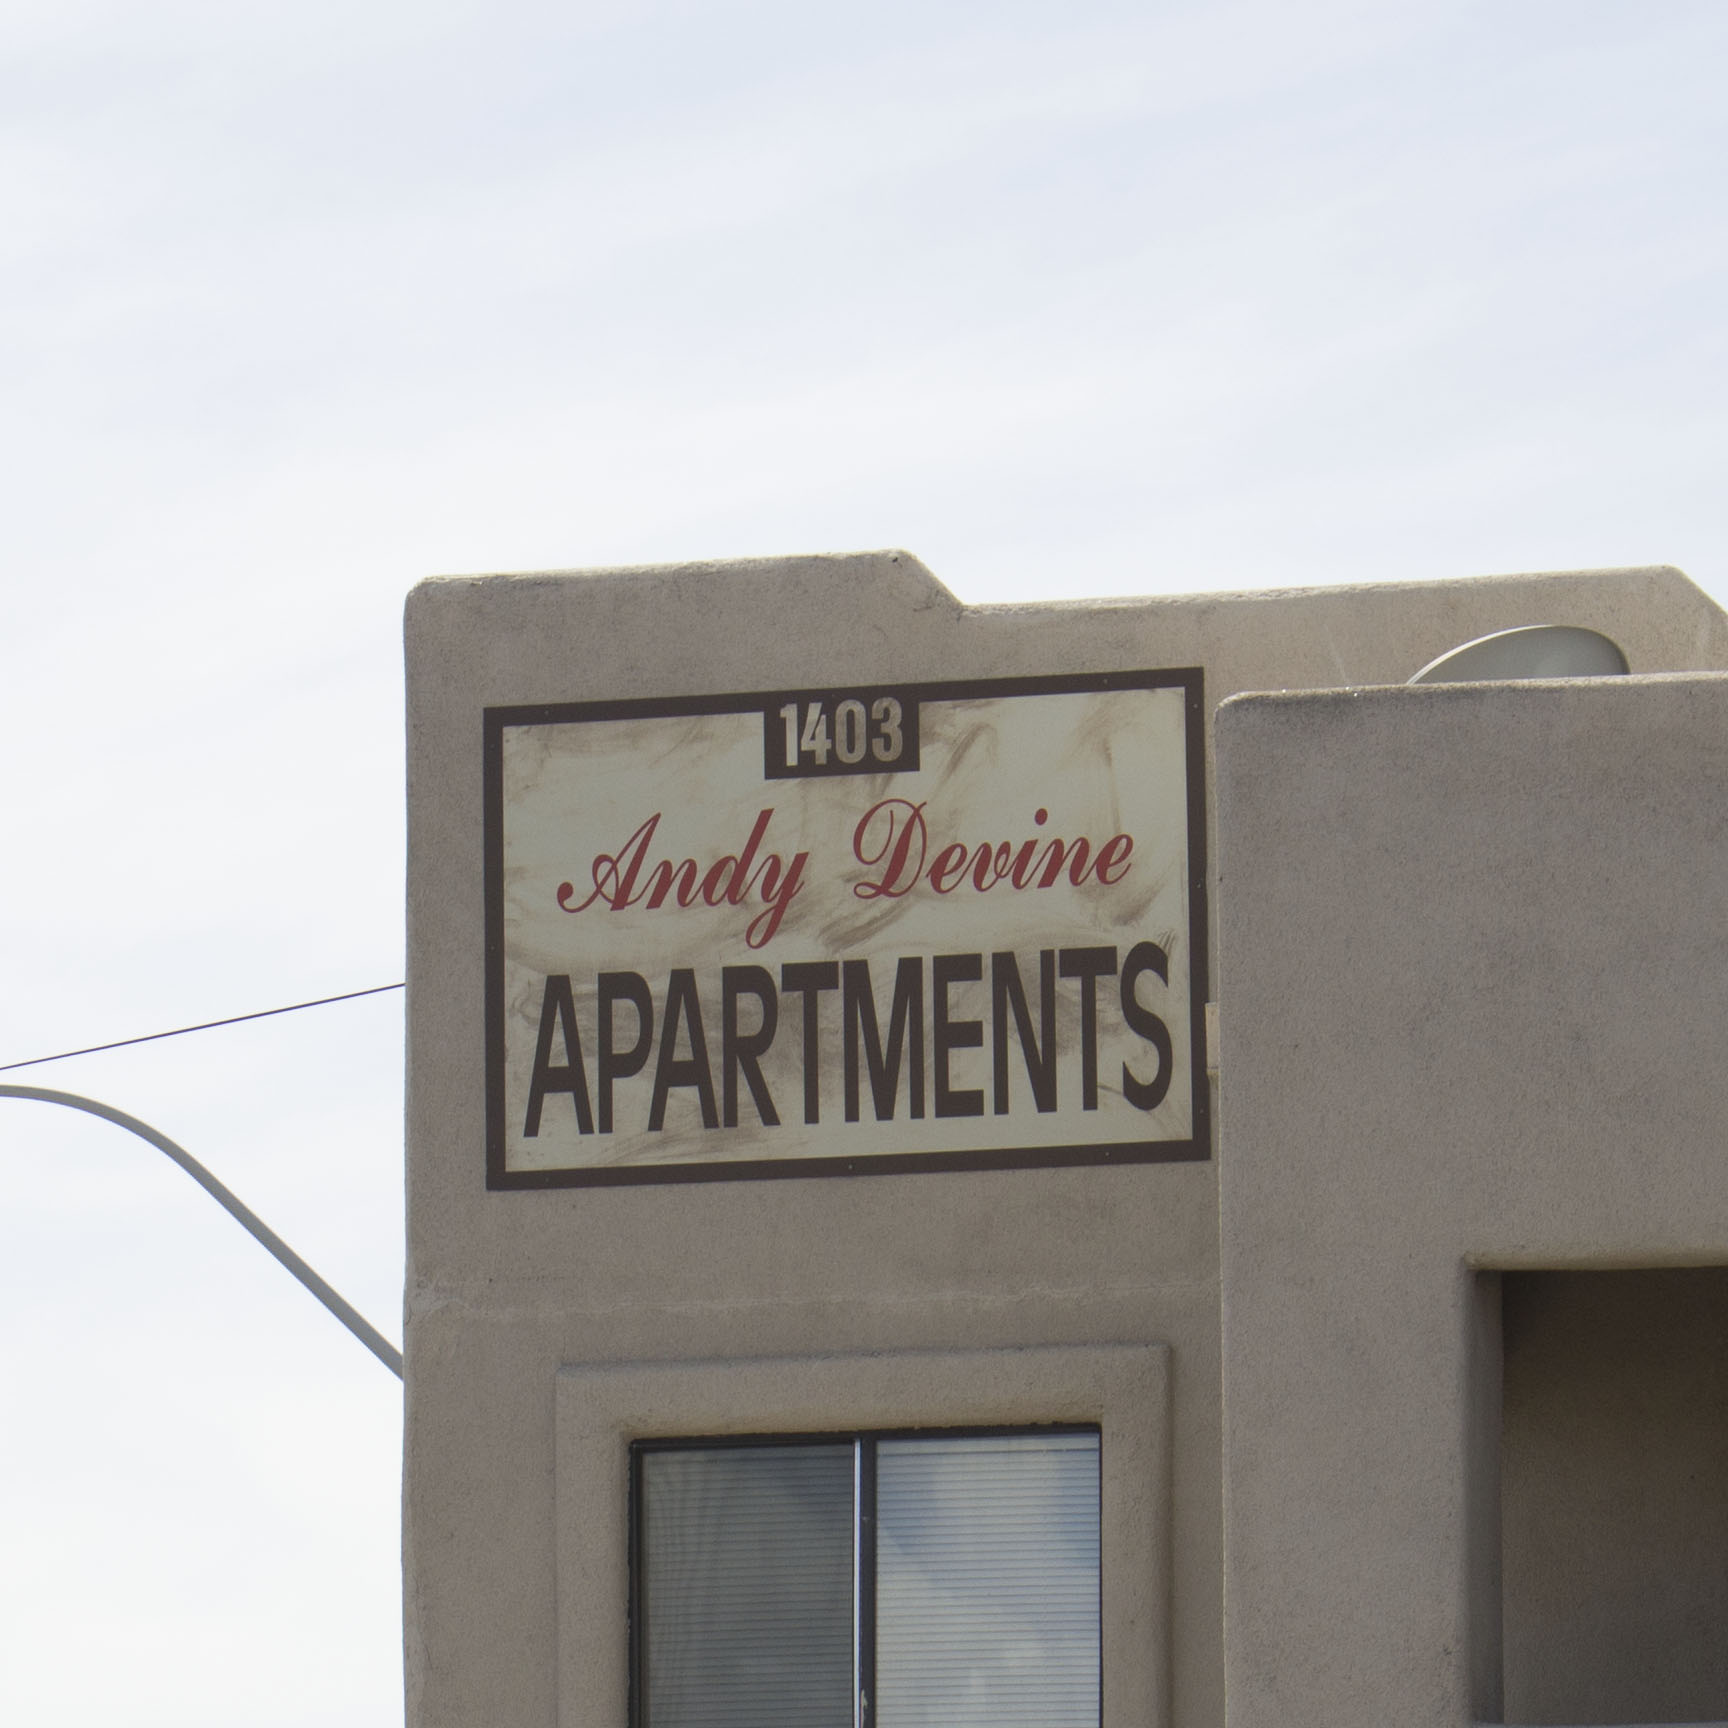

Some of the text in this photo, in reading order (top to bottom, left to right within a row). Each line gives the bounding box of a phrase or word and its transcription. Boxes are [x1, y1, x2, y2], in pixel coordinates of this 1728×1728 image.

[780, 697, 903, 767] 1403
[556, 798, 1134, 949] Andy Devine
[524, 941, 1173, 1137] APARTMENTS
